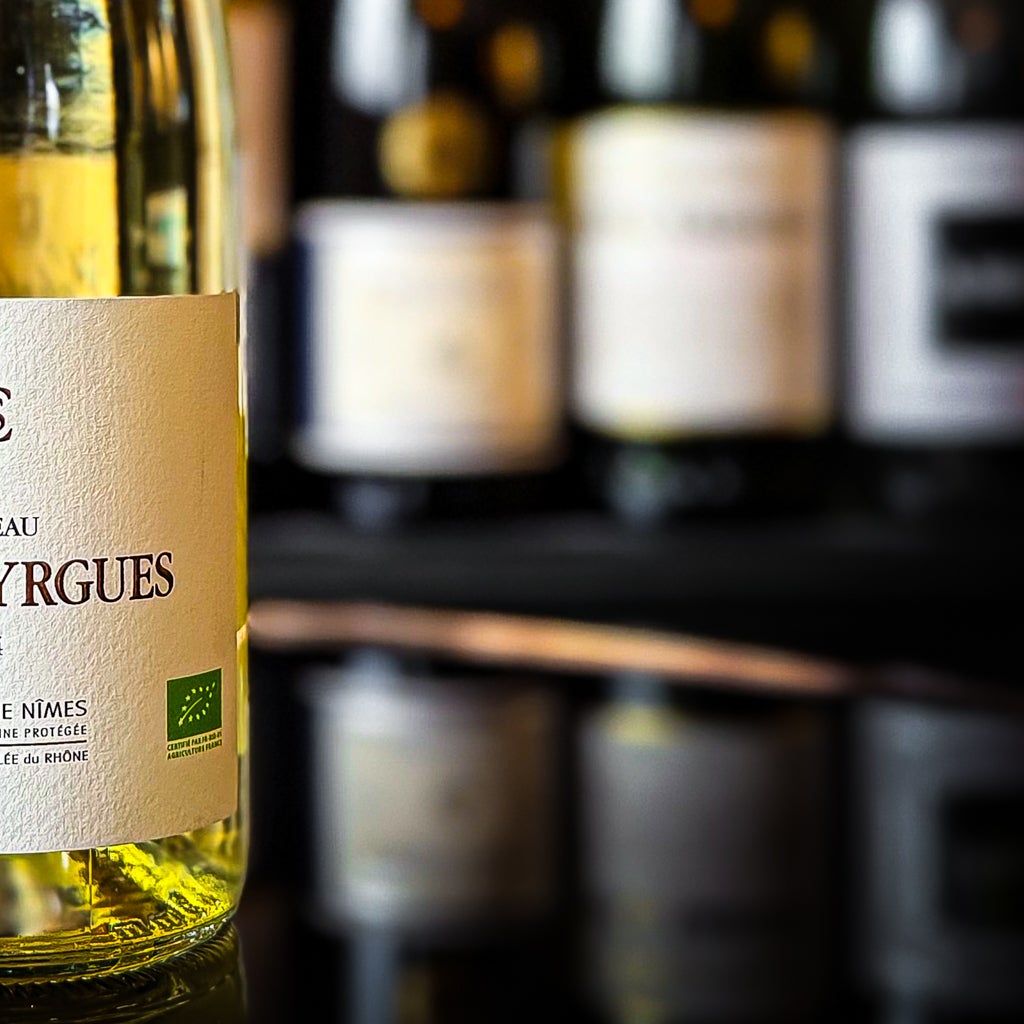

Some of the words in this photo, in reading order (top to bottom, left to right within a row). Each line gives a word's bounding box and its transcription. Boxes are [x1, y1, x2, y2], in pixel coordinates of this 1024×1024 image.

[22, 699, 88, 720] NÎMES
[24, 723, 88, 738] PROTÉGÉE
[23, 753, 40, 764] du
[44, 750, 89, 764] RHÔNE
